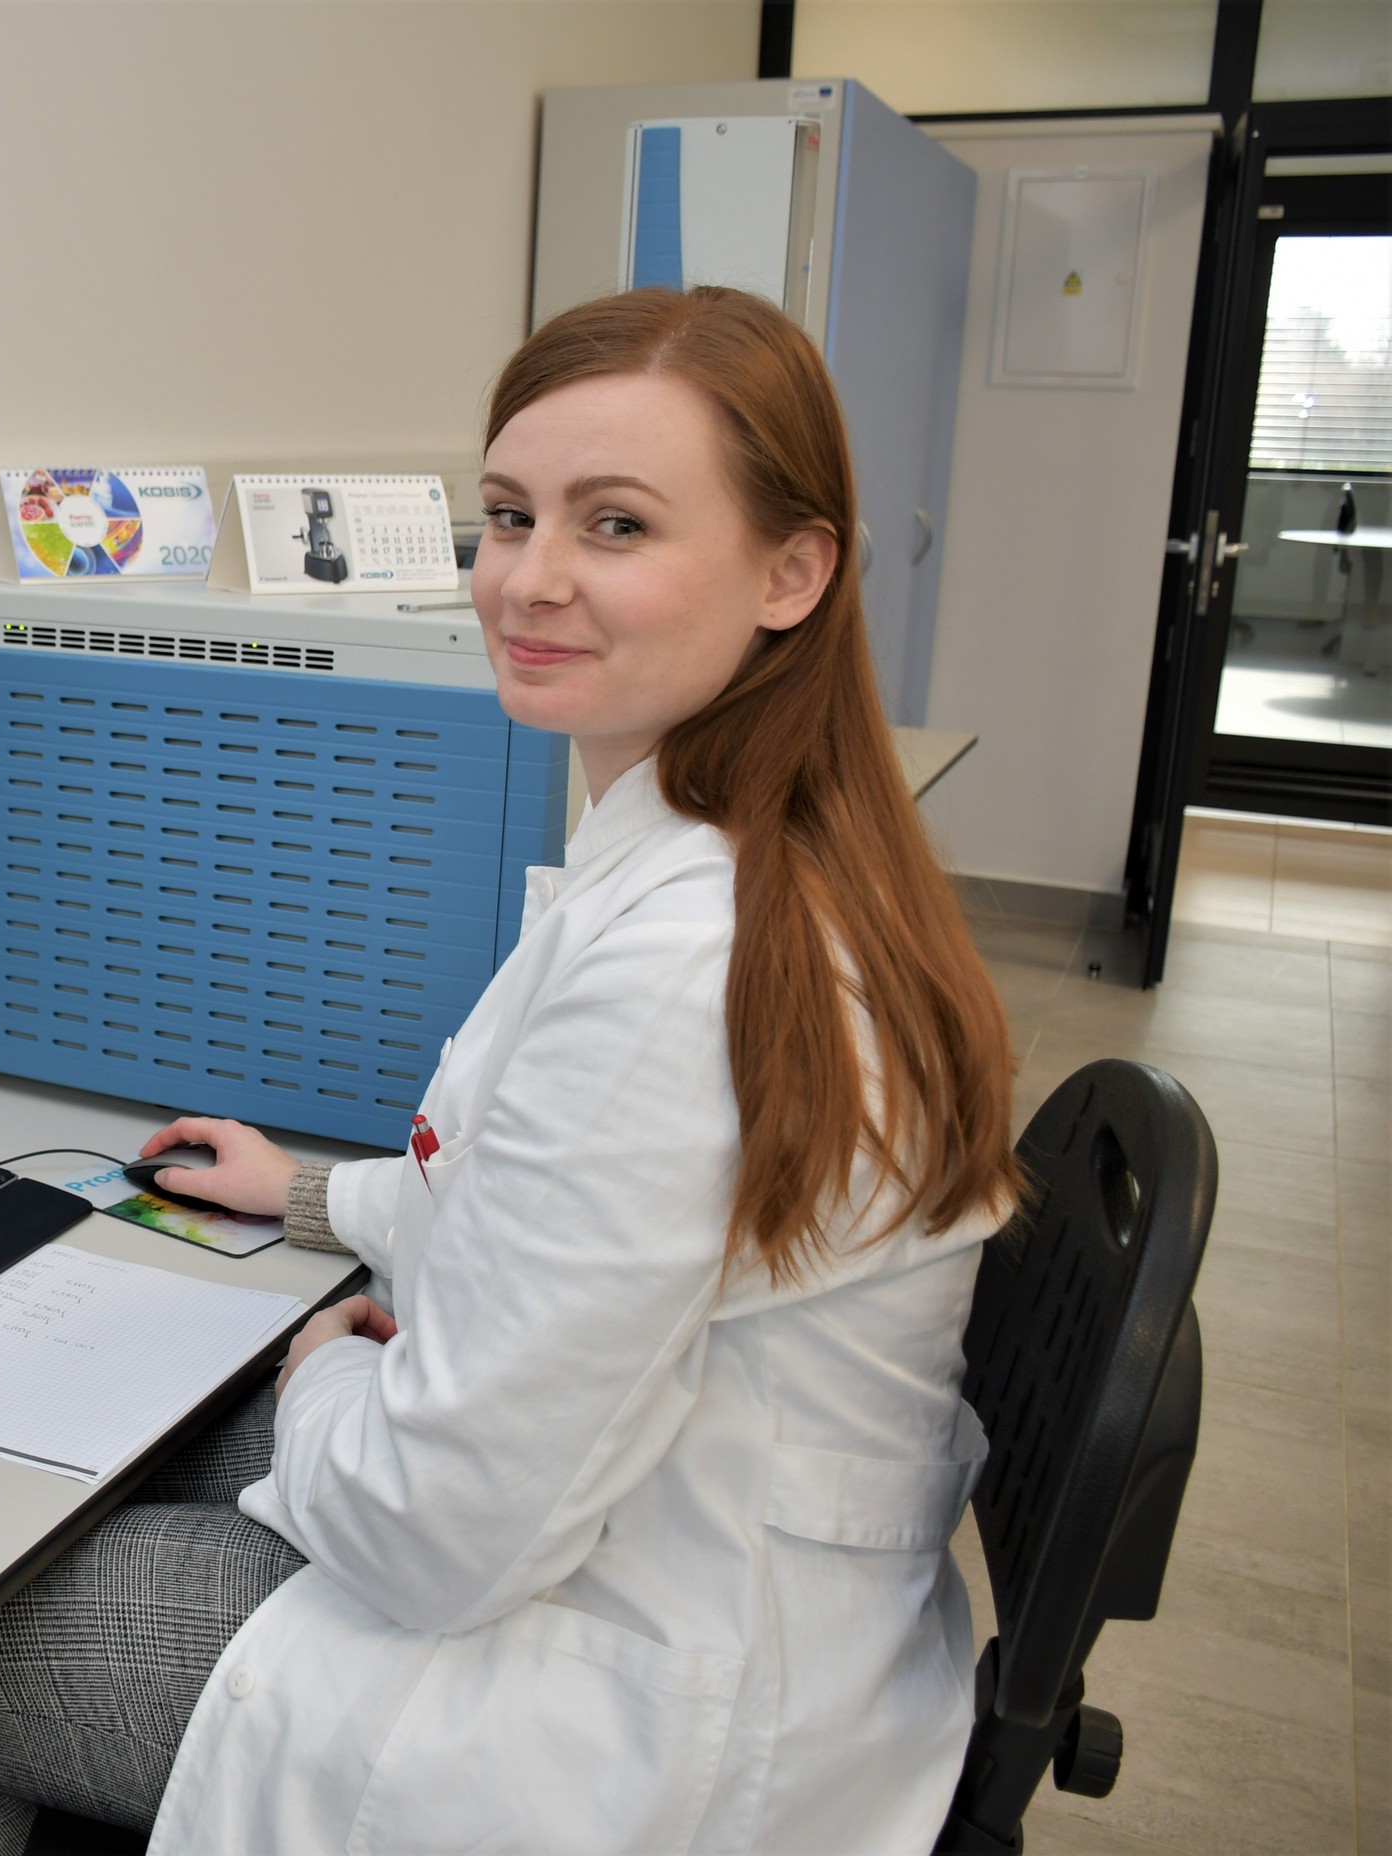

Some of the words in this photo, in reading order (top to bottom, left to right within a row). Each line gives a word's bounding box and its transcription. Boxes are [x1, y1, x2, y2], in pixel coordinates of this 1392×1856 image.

[138, 485, 197, 499] KOBIS
[159, 545, 213, 566] 2020
[360, 571, 392, 580] KOBIS
